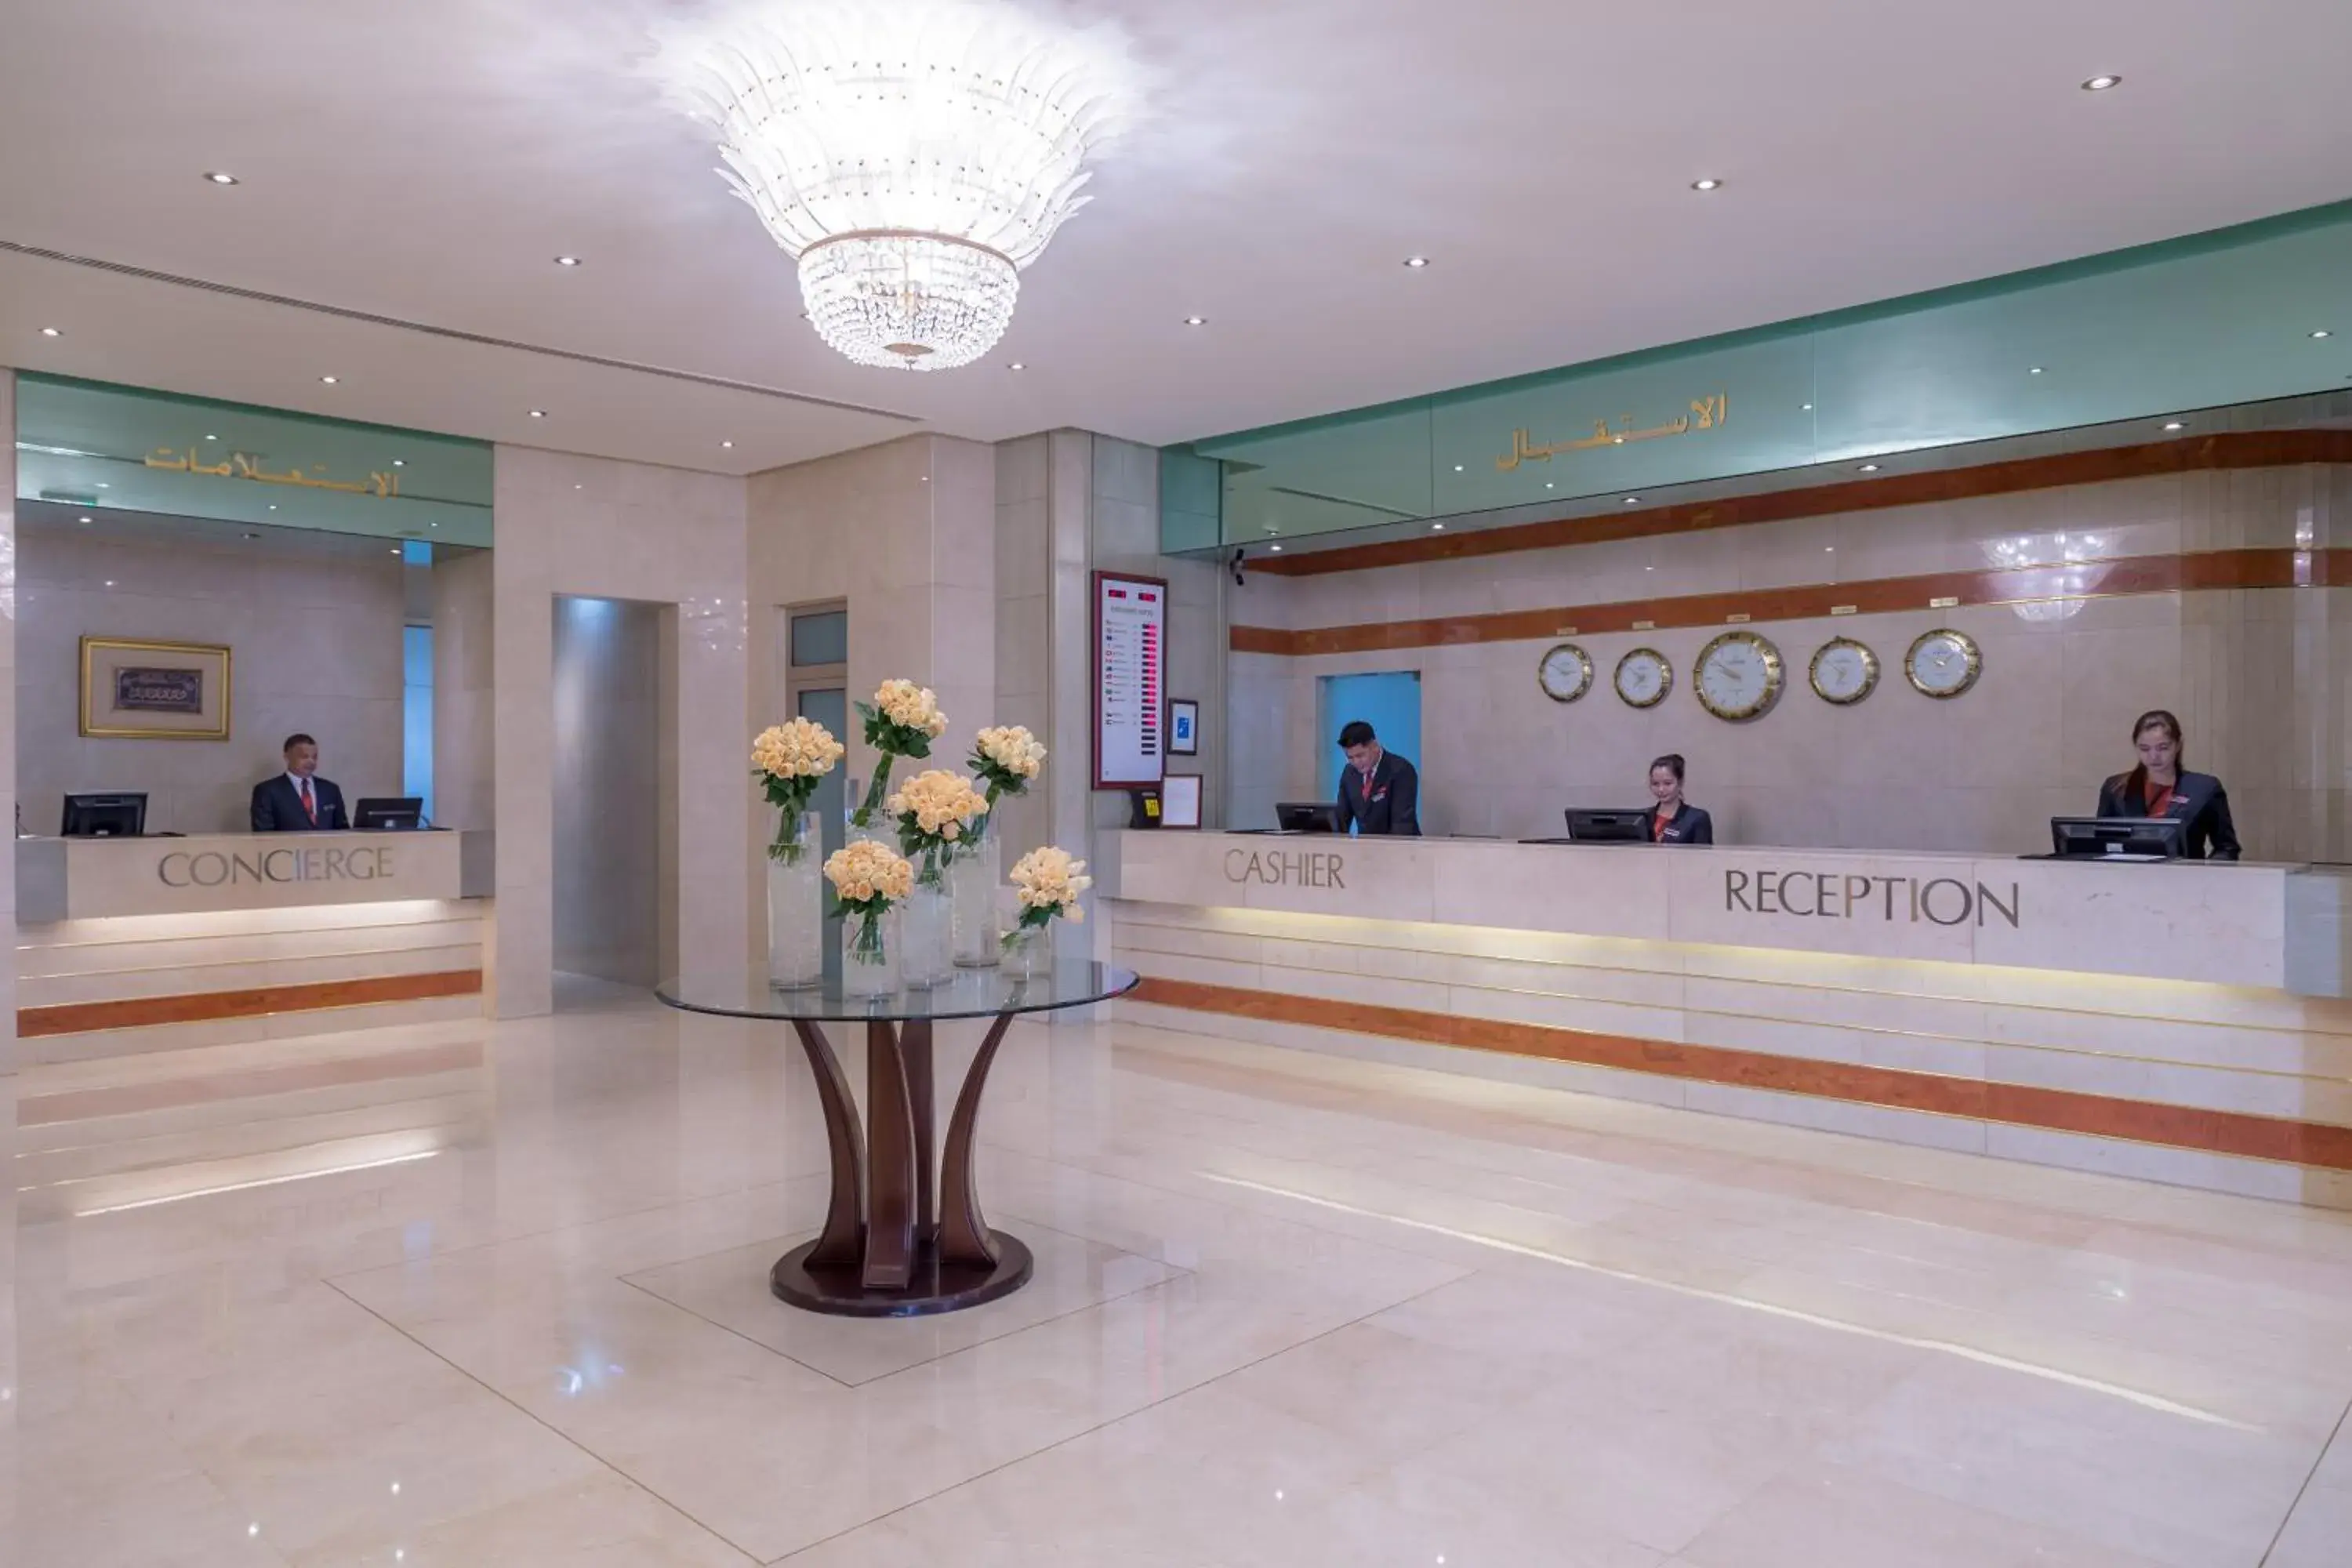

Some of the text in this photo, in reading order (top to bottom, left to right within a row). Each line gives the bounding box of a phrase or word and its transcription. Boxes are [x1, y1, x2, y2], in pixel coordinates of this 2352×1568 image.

[1496, 388, 1728, 470] الاستقبال
[145, 448, 398, 499] الاستعلامات
[158, 847, 394, 887] CONCIERGE
[1224, 848, 1346, 889] CASHIER
[1725, 869, 2019, 929] RECEPTION
